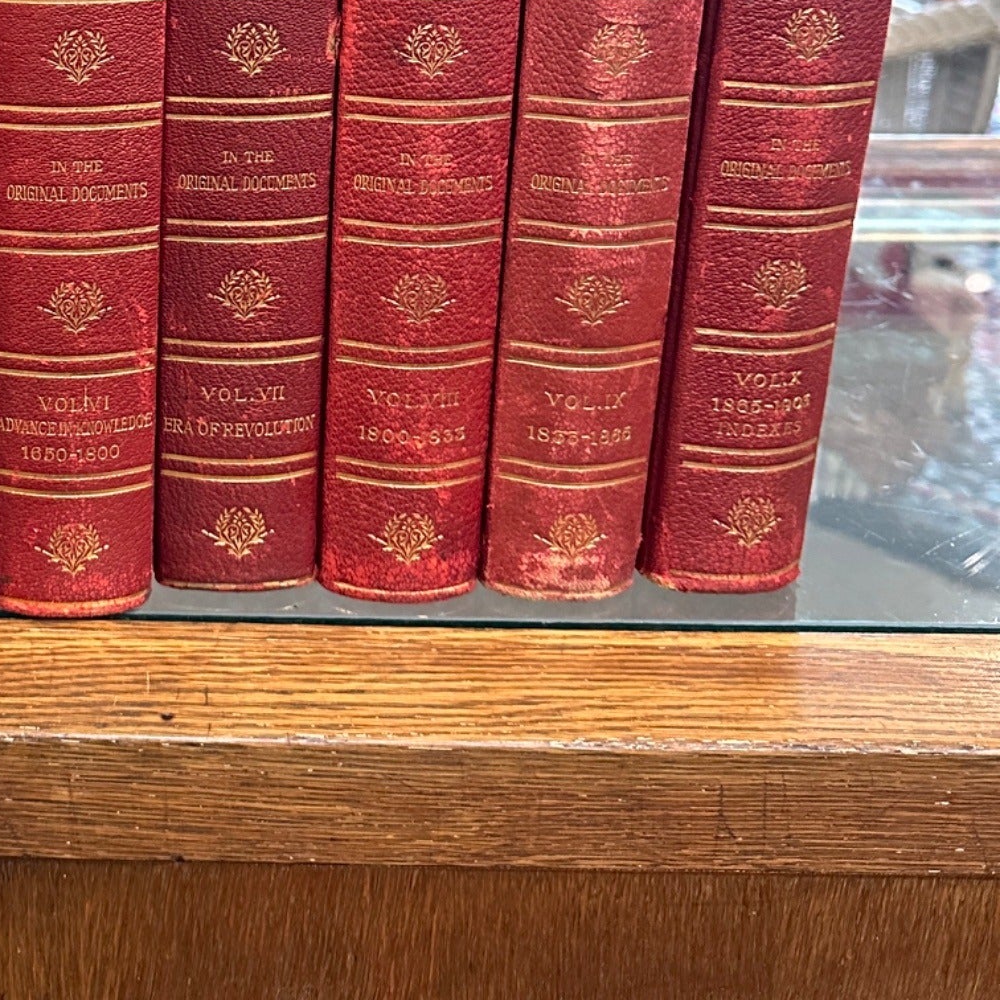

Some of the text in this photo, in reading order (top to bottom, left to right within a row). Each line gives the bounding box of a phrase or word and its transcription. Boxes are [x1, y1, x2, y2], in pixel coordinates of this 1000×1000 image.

[50, 160, 103, 173] IN THE
[221, 151, 274, 164] IN THE
[399, 153, 416, 166] IN
[721, 160, 784, 180] ORIGINAL
[7, 182, 148, 202] ORIGINAL DOCUMENTS
[178, 173, 316, 192] ORIGINAL DOCUMENTS
[354, 174, 415, 195] ORIGINAL
[599, 175, 671, 197] OCUMENTS
[75, 412, 153, 437] KNOWLEDGE
[163, 414, 316, 438] ERA OF REVOLUTION
[714, 421, 802, 438] INDEXES
[21, 444, 120, 462] 1650-1800
